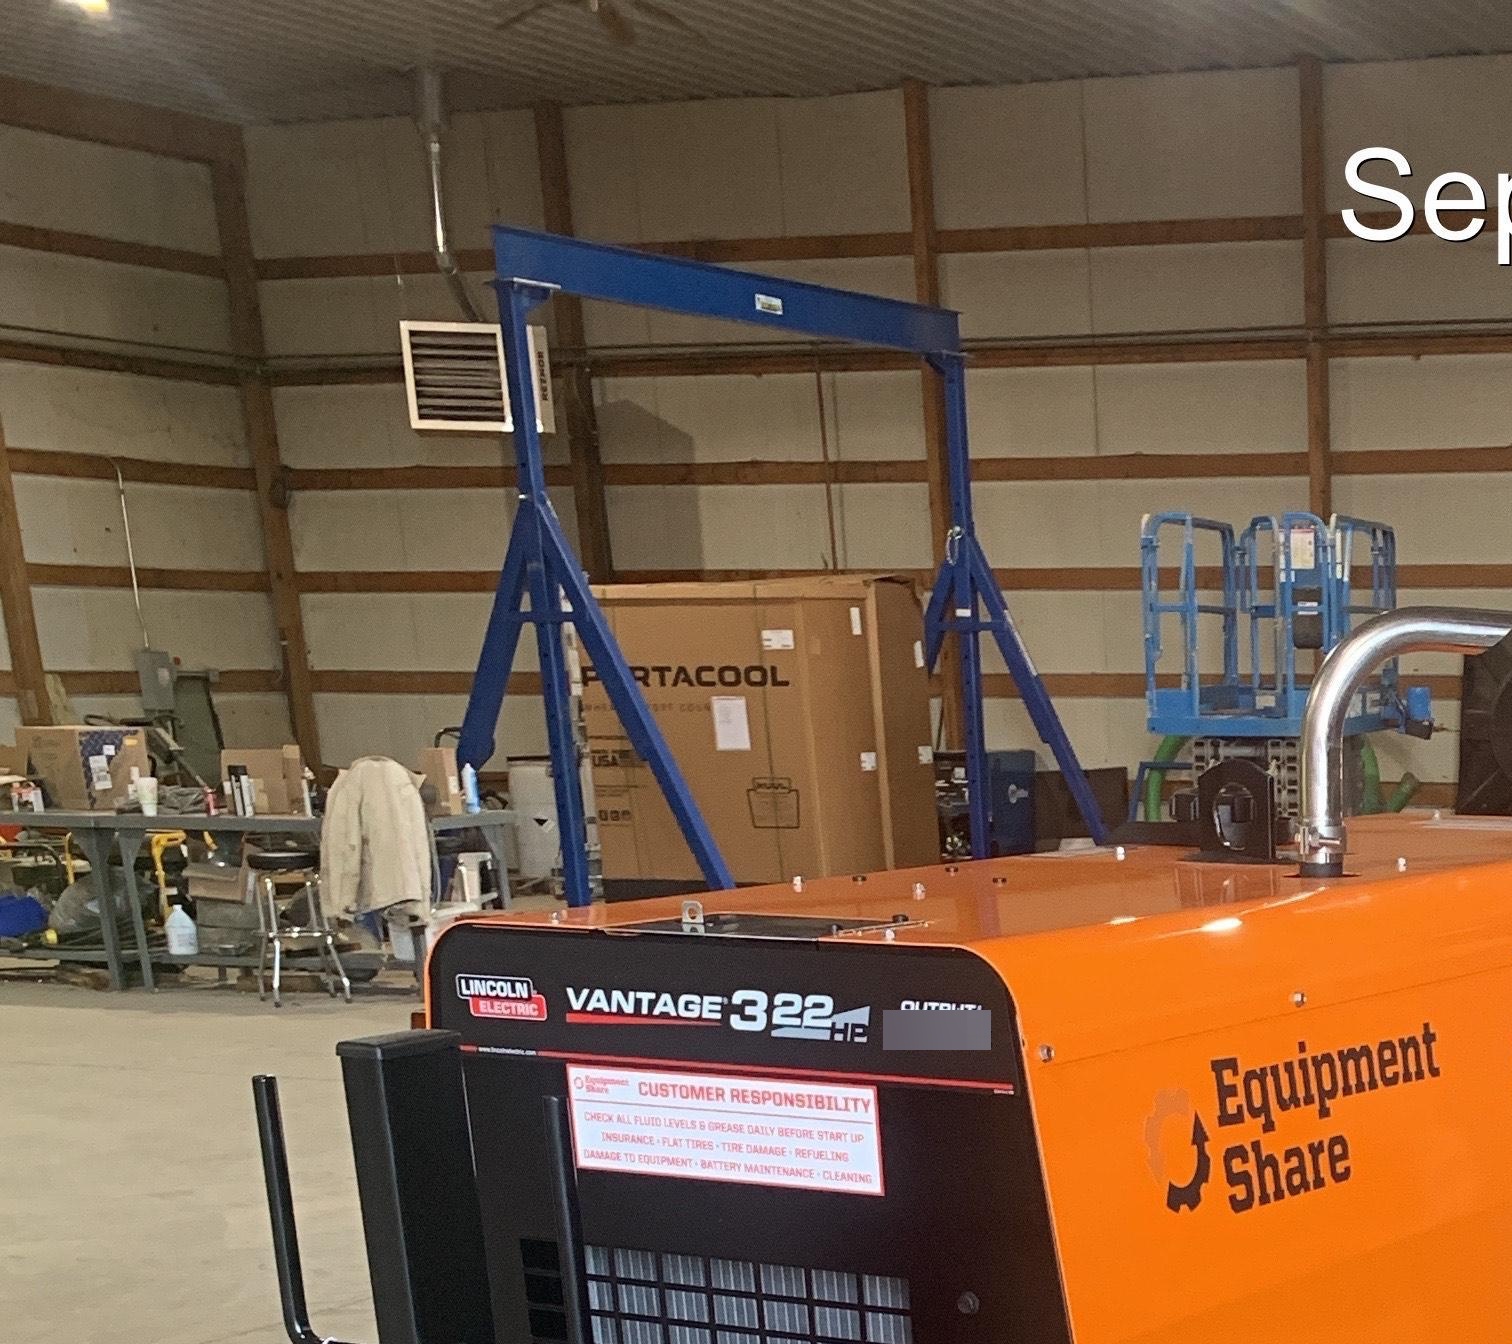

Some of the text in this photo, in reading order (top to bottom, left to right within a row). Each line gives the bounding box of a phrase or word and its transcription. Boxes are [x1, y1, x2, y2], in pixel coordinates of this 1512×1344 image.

[581, 665, 790, 687] PRTACOOL
[460, 978, 530, 999] LINCOLN
[566, 986, 723, 1019] VANTAGE
[479, 1000, 539, 1017] ELECTRIC
[1211, 1022, 1440, 1133] Equipment
[638, 1081, 872, 1114] CUSTOMER RESPONSIBILITY
[584, 1111, 614, 1124] CHECK
[616, 1113, 632, 1125] ALL
[634, 1115, 662, 1128] FLUID
[664, 1117, 697, 1131] LEVELS
[708, 1121, 745, 1134] GREASE
[747, 1124, 775, 1137] DAILY
[778, 1127, 815, 1141] BEFORE
[817, 1130, 848, 1142] START
[850, 1133, 864, 1144] UP
[601, 1131, 850, 1163] INSURANCE FLAT TIRES TIRE DAMAGE REFUELING
[583, 1148, 873, 1184] DAMAGE TO EQUIPMENT BATTERY MAINTENANCE CLEANING
[1223, 1134, 1352, 1214] Share
